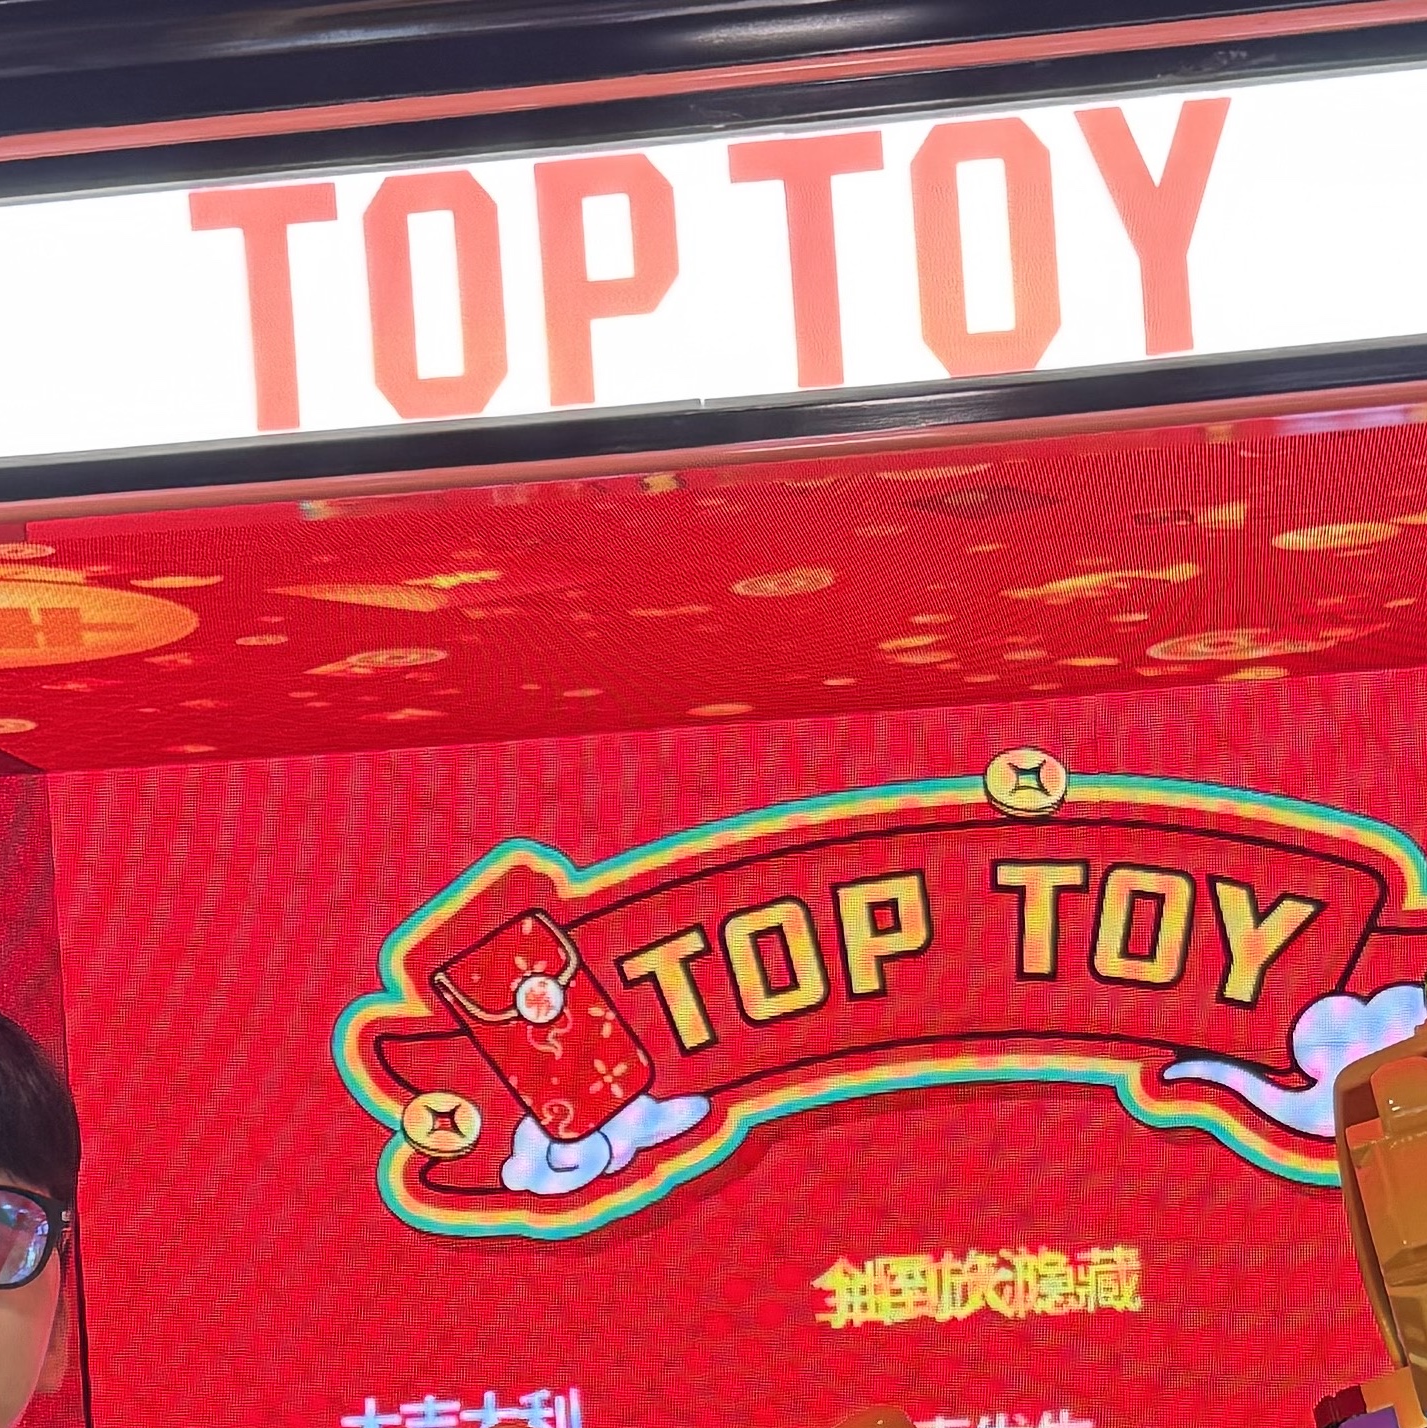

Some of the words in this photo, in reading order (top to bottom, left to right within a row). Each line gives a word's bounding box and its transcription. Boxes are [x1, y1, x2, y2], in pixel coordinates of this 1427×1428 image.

[189, 151, 680, 432] TOP
[727, 97, 1231, 389] TOY
[620, 870, 934, 1057] TOP
[994, 858, 1324, 1010] TOY
